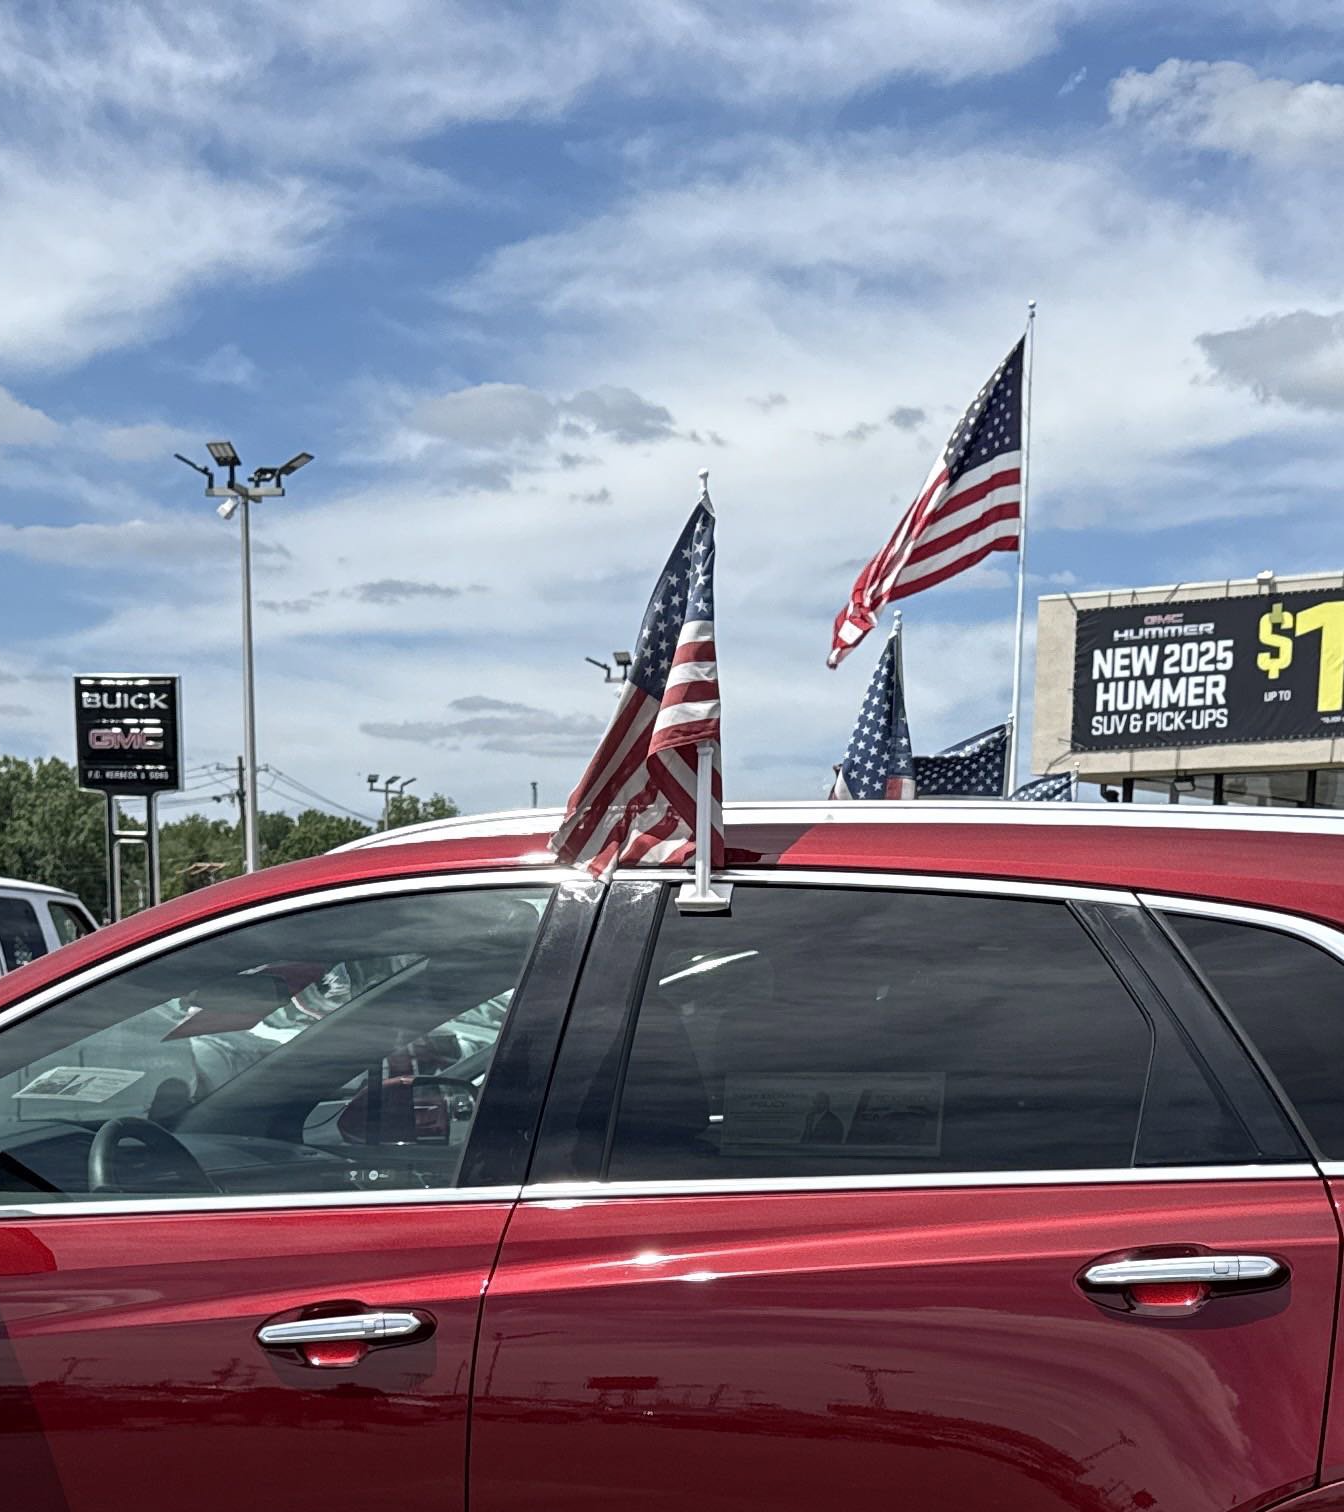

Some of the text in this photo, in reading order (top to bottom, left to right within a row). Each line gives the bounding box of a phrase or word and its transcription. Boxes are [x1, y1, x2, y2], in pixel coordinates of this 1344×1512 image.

[1143, 613, 1184, 626] GMC
[1113, 622, 1215, 642] HUMMER
[1091, 639, 1234, 680] NEW 2025
[81, 691, 169, 709] BUICK
[1095, 674, 1227, 713] HUMMER
[1263, 690, 1292, 702] UP TO
[1091, 708, 1229, 736] SUV & PICK-UPS
[89, 728, 163, 749] GMC
